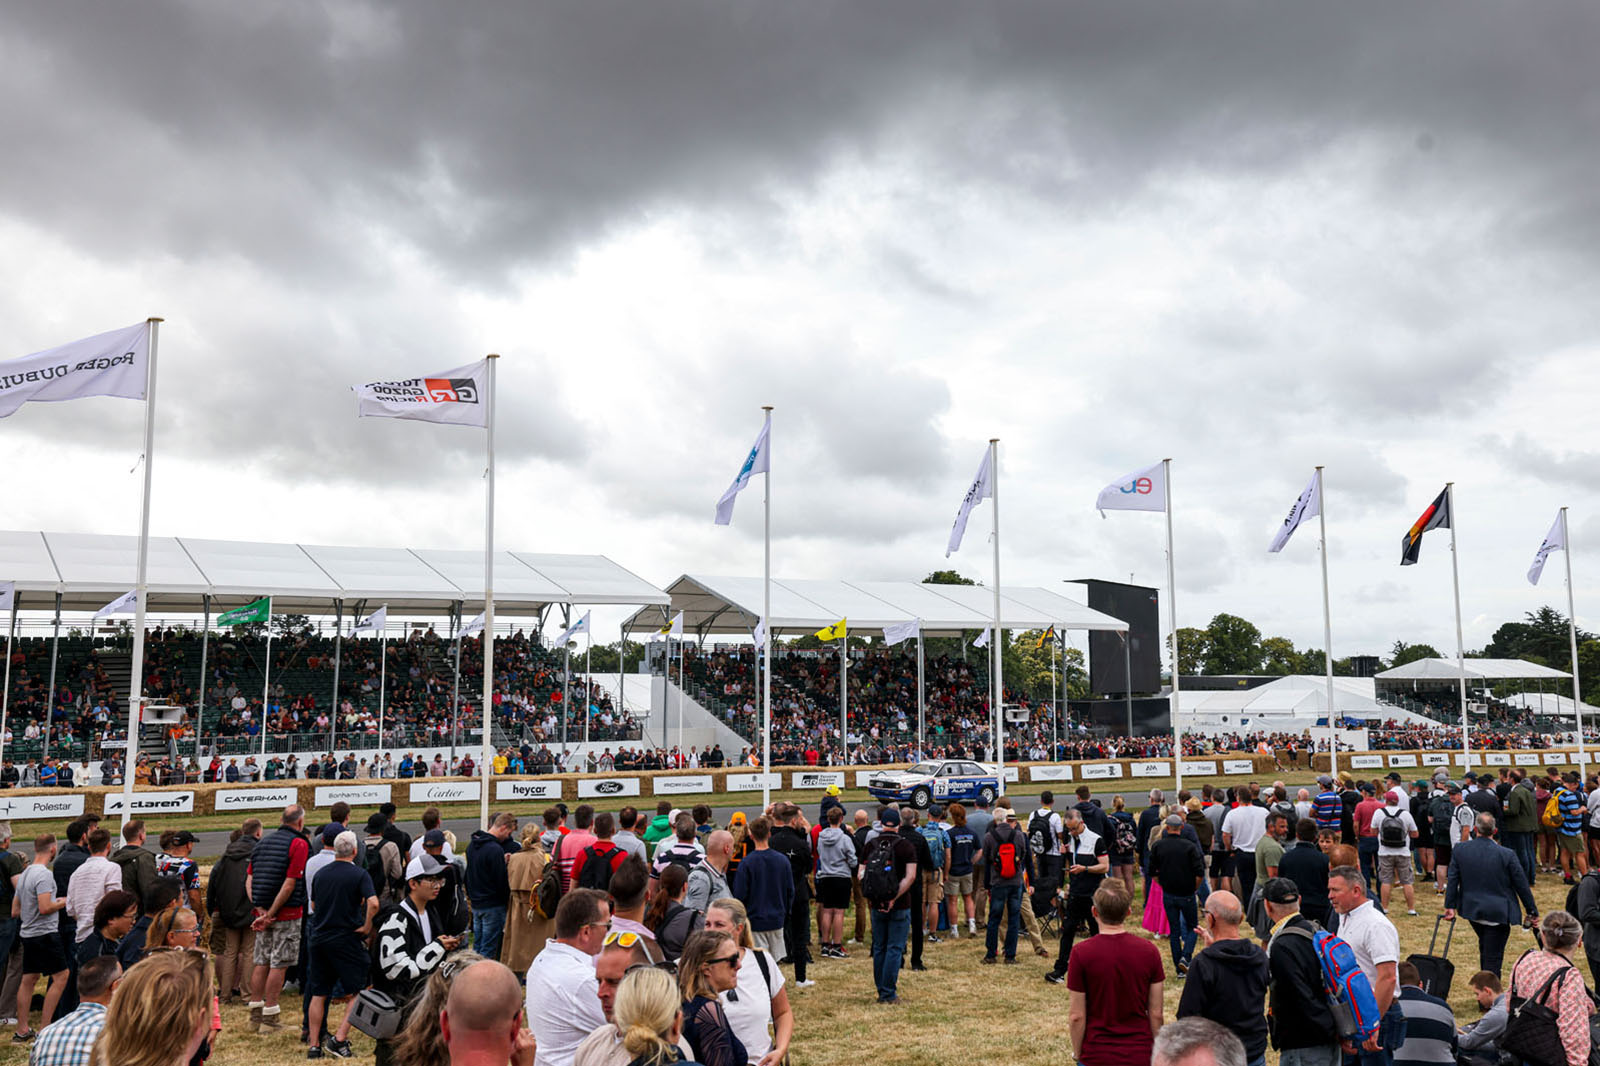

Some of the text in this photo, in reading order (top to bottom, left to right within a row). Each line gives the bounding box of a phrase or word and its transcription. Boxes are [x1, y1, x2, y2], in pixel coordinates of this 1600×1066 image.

[427, 786, 464, 798] Cartier
[512, 784, 546, 796] heycar
[600, 784, 619, 793] Ford
[938, 785, 946, 794] 57
[224, 794, 287, 803] CATERHAM
[33, 802, 72, 811] Polestar
